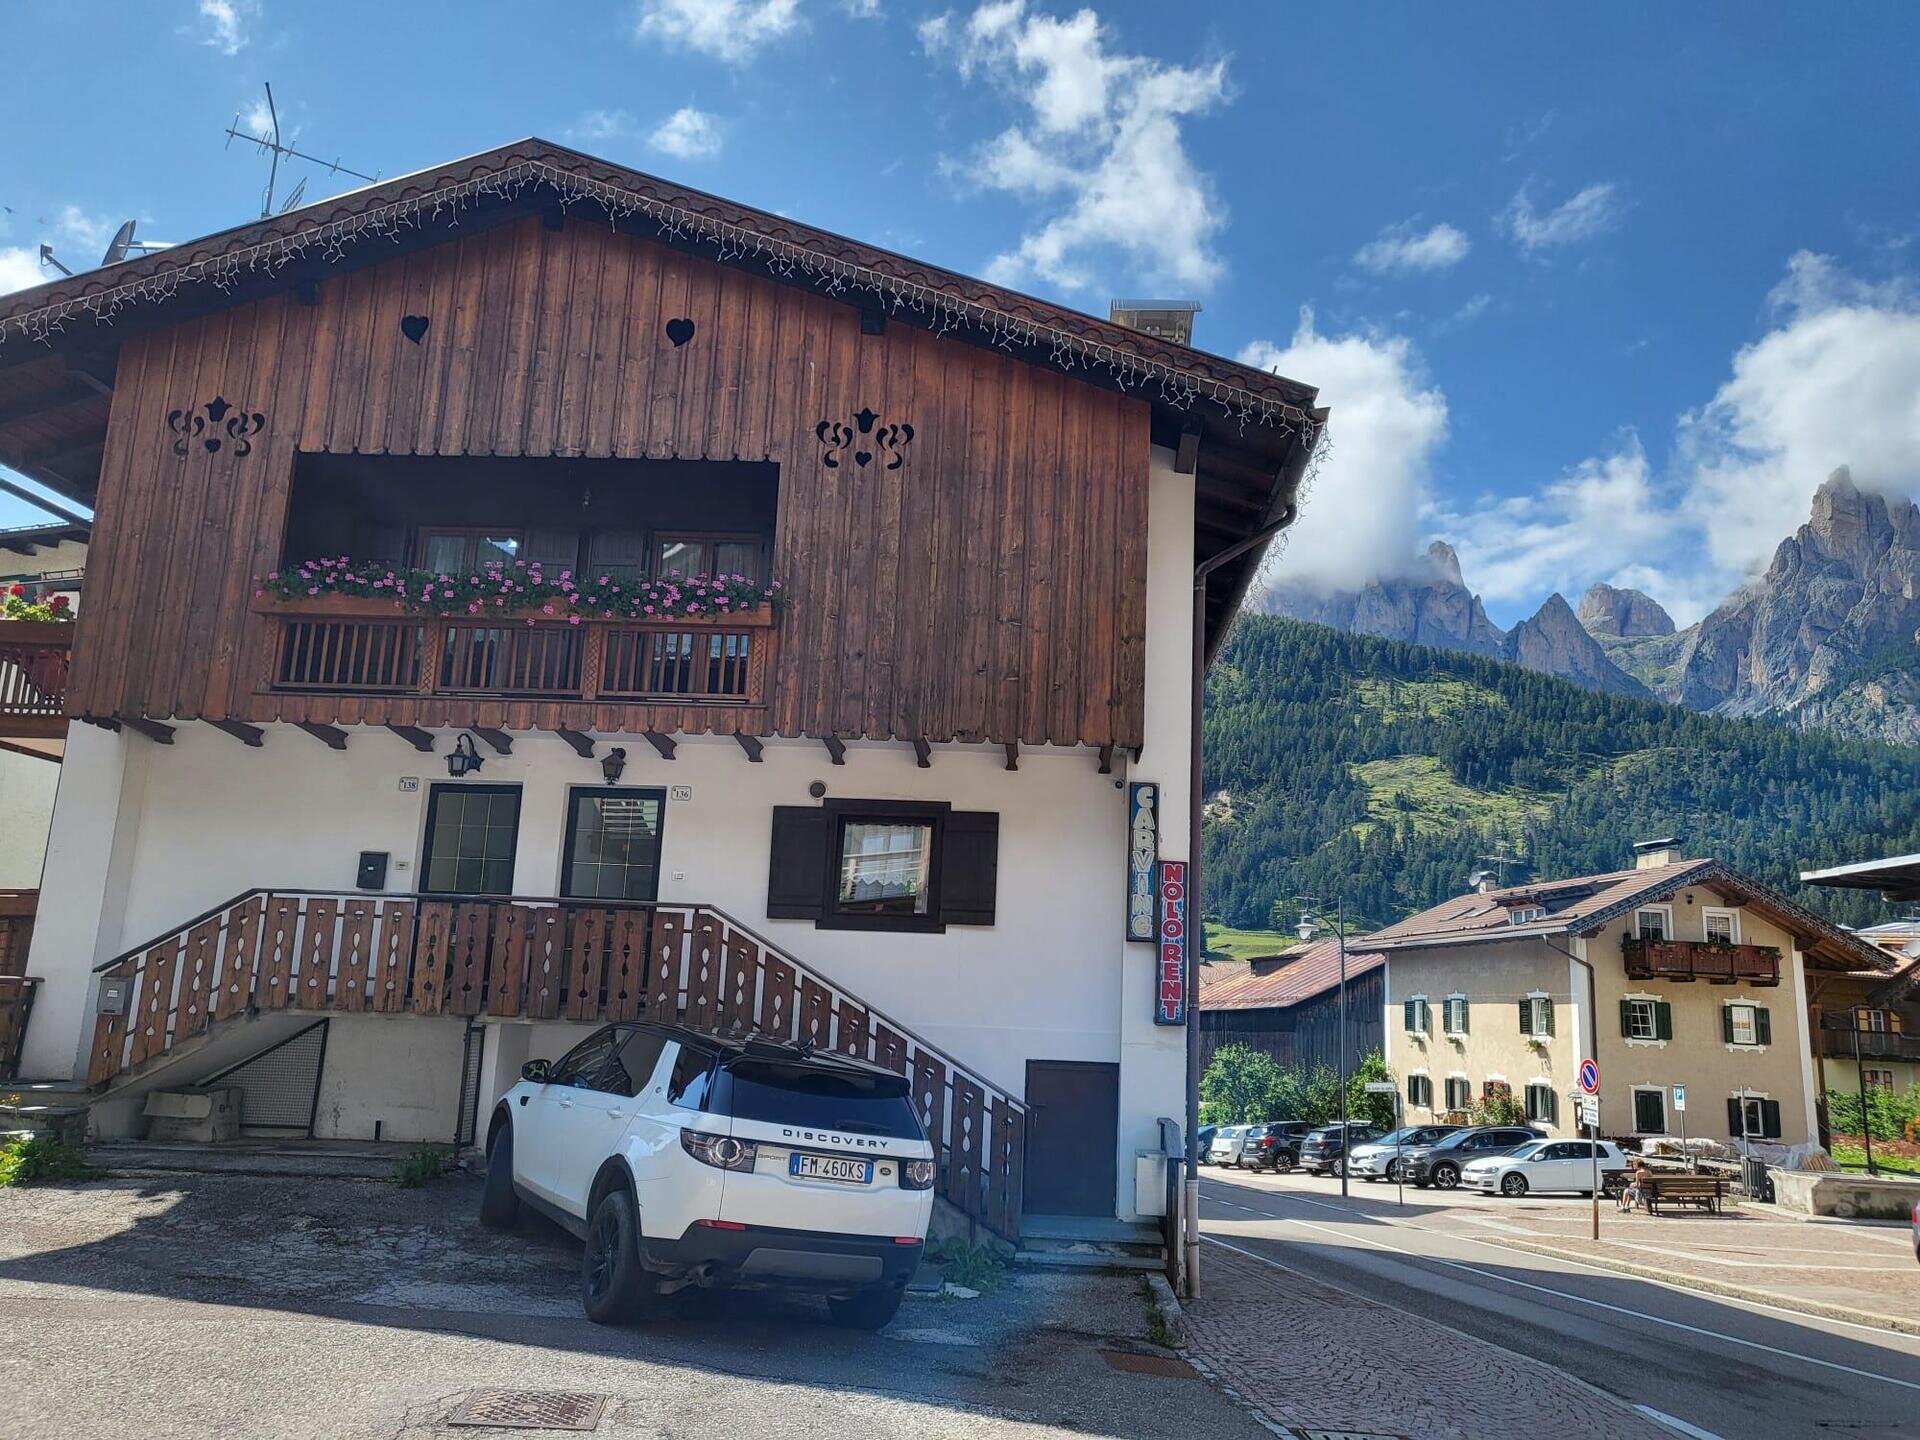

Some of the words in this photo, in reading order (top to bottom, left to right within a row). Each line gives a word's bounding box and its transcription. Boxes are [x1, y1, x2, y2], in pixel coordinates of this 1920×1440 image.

[676, 790, 689, 798] 136
[1132, 786, 1155, 937] CARVING
[783, 1129, 888, 1148] DISCOVERY
